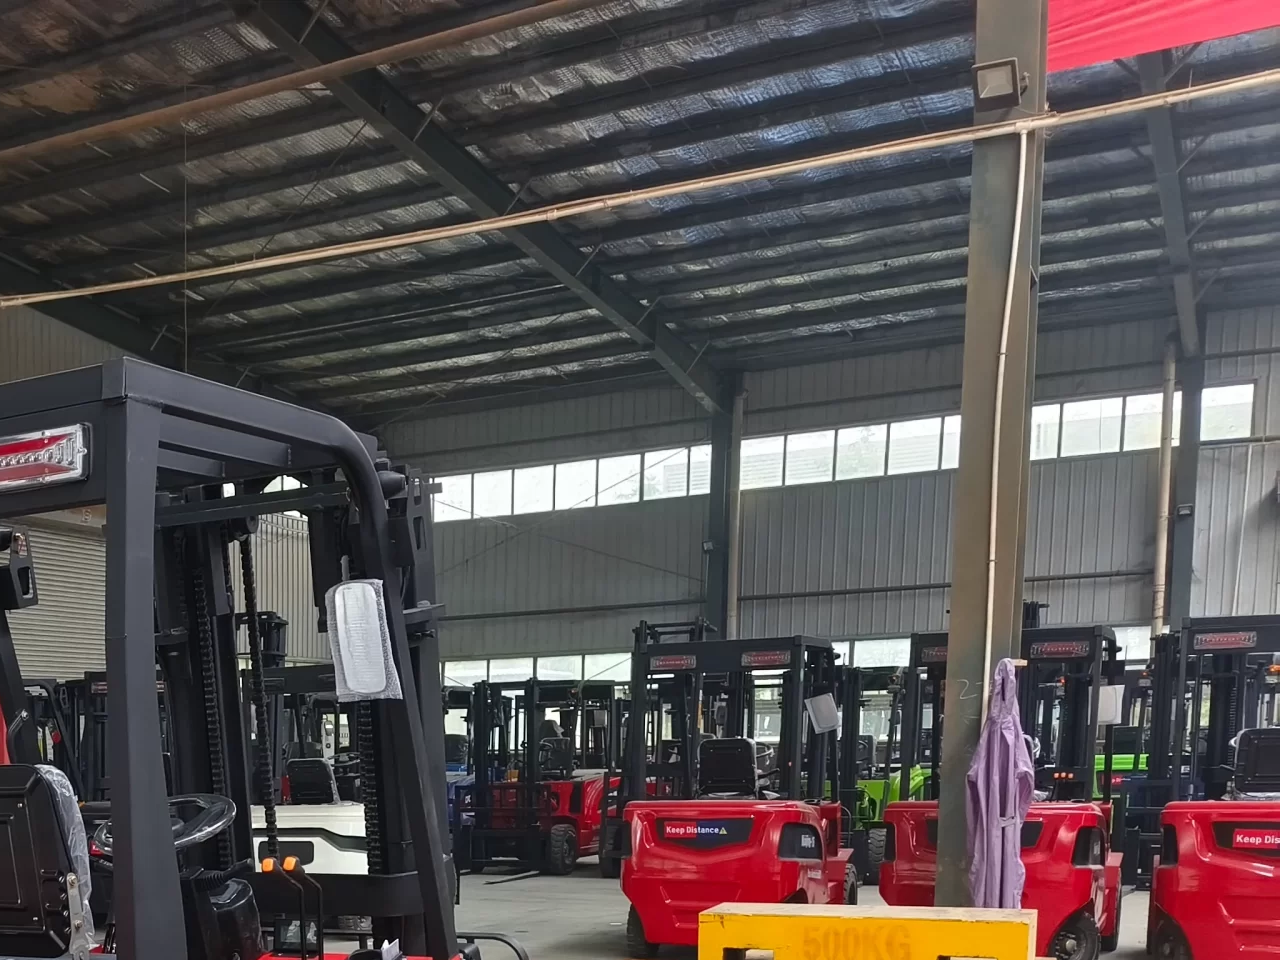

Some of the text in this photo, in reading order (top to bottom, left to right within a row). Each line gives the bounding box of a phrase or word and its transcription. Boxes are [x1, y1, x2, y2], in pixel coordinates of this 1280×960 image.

[666, 826, 719, 835] Keep Distance
[1236, 834, 1262, 846] Keep
